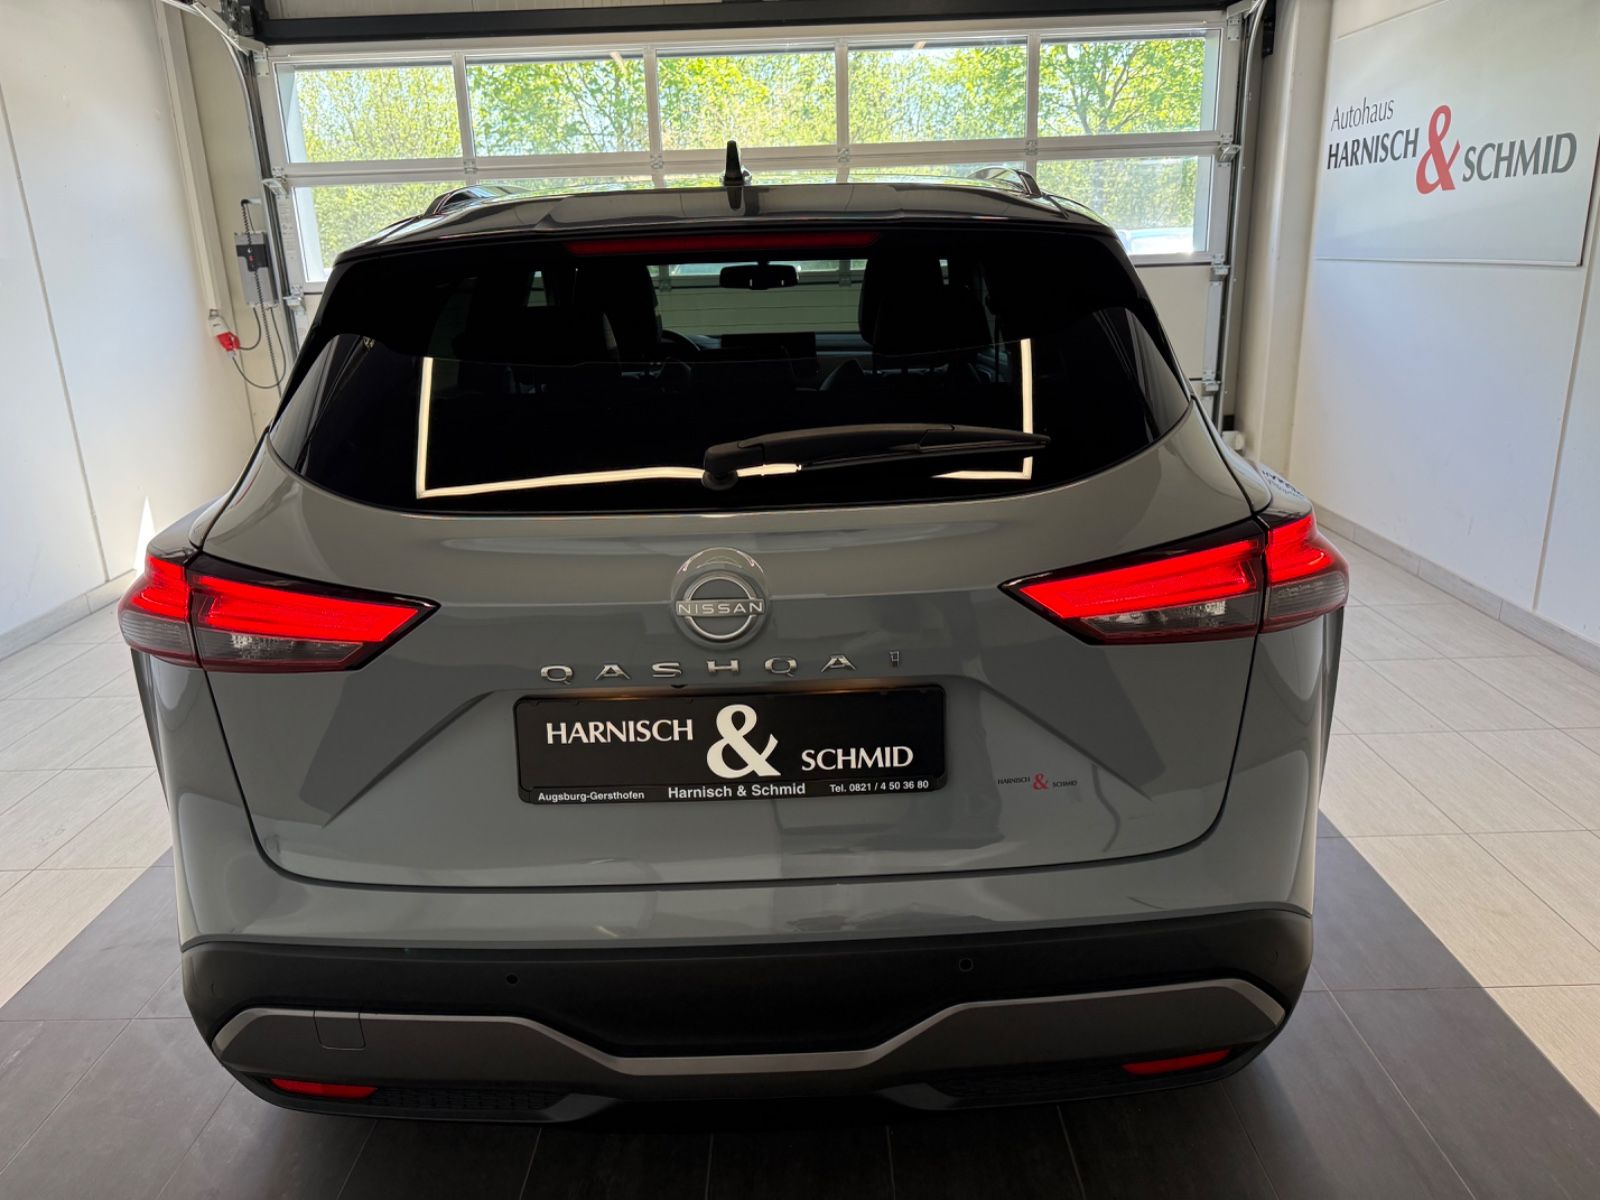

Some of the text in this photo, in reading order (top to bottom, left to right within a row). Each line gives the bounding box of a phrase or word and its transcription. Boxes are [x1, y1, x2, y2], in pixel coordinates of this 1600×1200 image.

[1330, 97, 1395, 131] Autohaus
[1326, 104, 1578, 195] HARNISCH & SCHMID
[678, 602, 763, 614] NISSAN
[540, 650, 900, 685] QASHQAI
[546, 704, 914, 779] HARNISCH & SCHMID
[829, 783, 847, 793] Tel.
[848, 783, 872, 792] 0821
[880, 782, 886, 790] 4
[888, 781, 901, 790] 50
[902, 780, 915, 790] 36
[917, 780, 929, 789] 80
[1032, 773, 1049, 790] &
[538, 790, 645, 803] Augsburg-Gersthofen
[668, 782, 806, 799] Harnisch & Schmid
